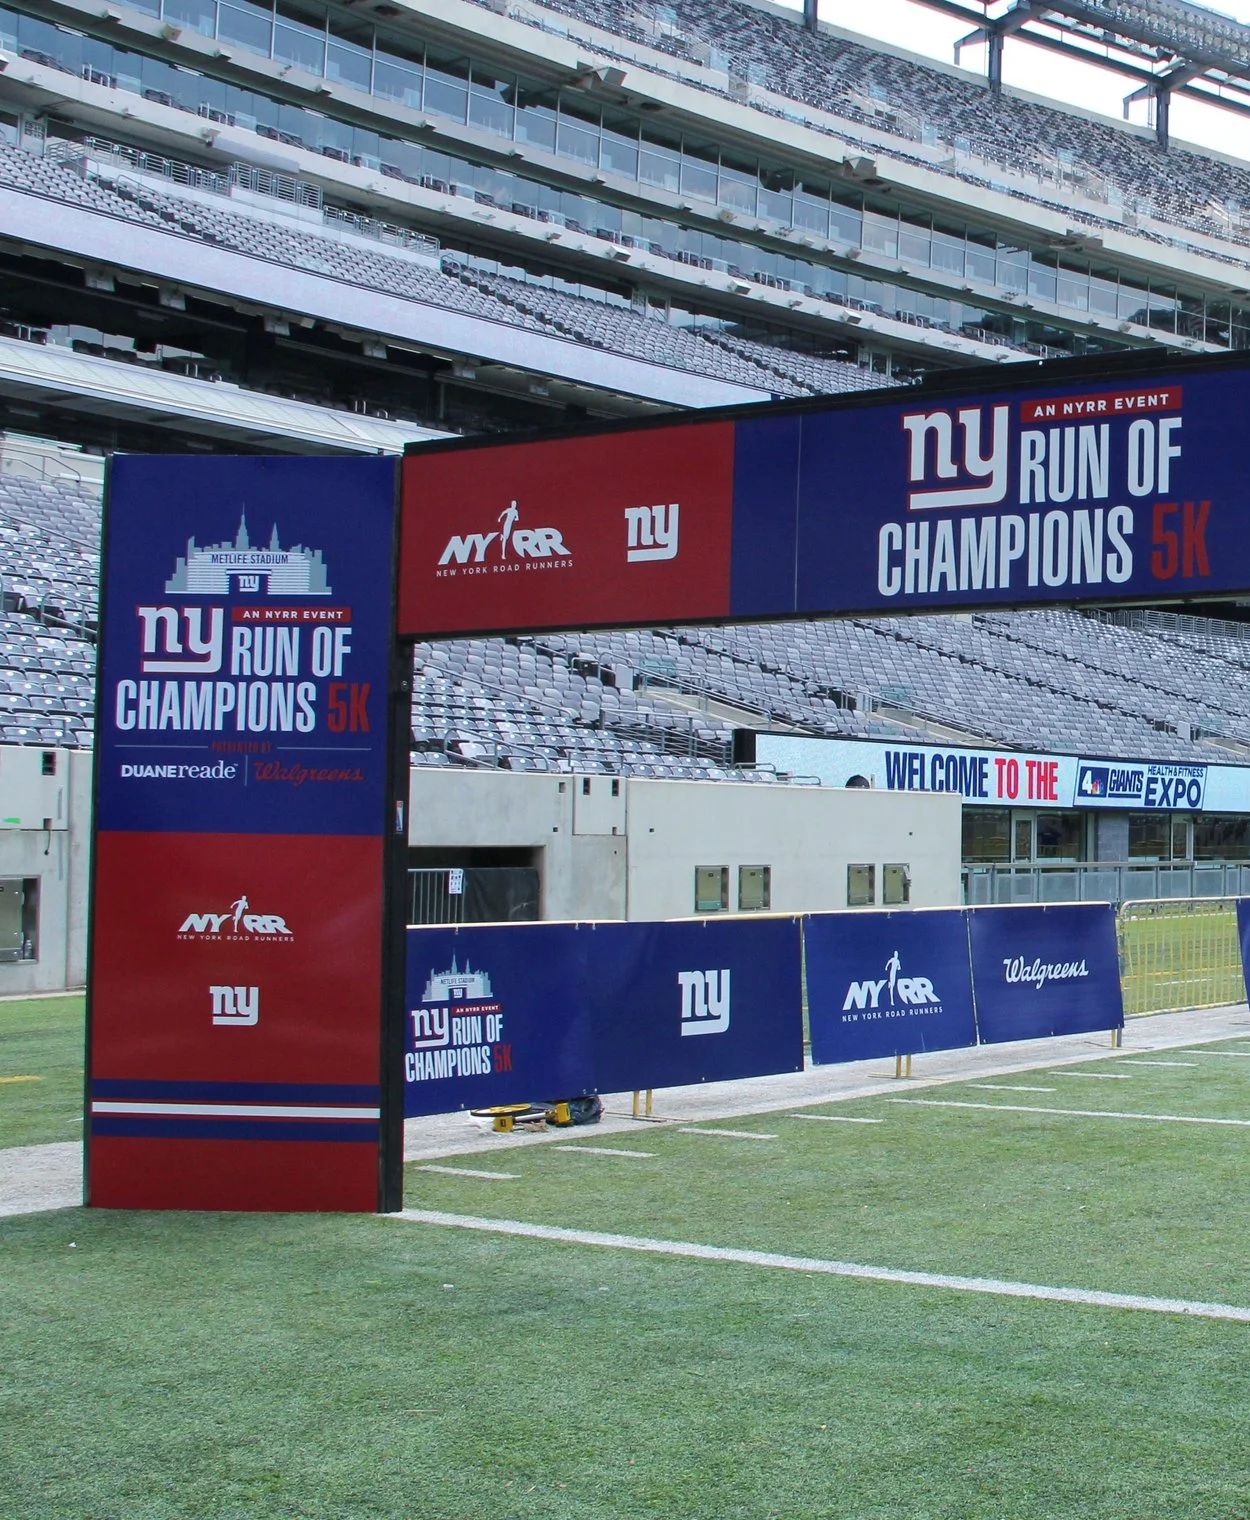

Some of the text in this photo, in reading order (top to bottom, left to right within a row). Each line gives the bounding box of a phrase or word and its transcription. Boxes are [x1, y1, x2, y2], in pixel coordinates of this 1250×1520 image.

[1034, 393, 1169, 418] AN NYRR EVENT
[903, 405, 1009, 510] ny
[1019, 417, 1182, 504] RUN OF
[625, 503, 679, 562] ny
[877, 501, 1212, 597] CHAMPIONS 5K
[212, 554, 288, 564] METLIFE STADIUM
[436, 559, 573, 577] NEW YORK ROAD RUNNERS
[243, 610, 343, 620] AN NYRR EVENT
[138, 606, 224, 673] ny
[231, 626, 352, 677] RUN OF
[115, 679, 371, 733] CHAMPIONS 5K
[253, 762, 365, 787] Walgreens
[885, 750, 1058, 800] WELCOME TO THE
[1109, 769, 1144, 793] GIANTS
[1144, 777, 1201, 807] EXPO
[1003, 955, 1089, 990] Walgreens
[210, 985, 259, 1026] ny
[678, 969, 730, 1037] ny
[842, 1006, 943, 1022] NEW YORK ROAD RUNNERS
[411, 1008, 449, 1048] ny
[452, 1014, 503, 1045] RUN OF
[405, 1044, 512, 1083] CHAMPIONS 5K
